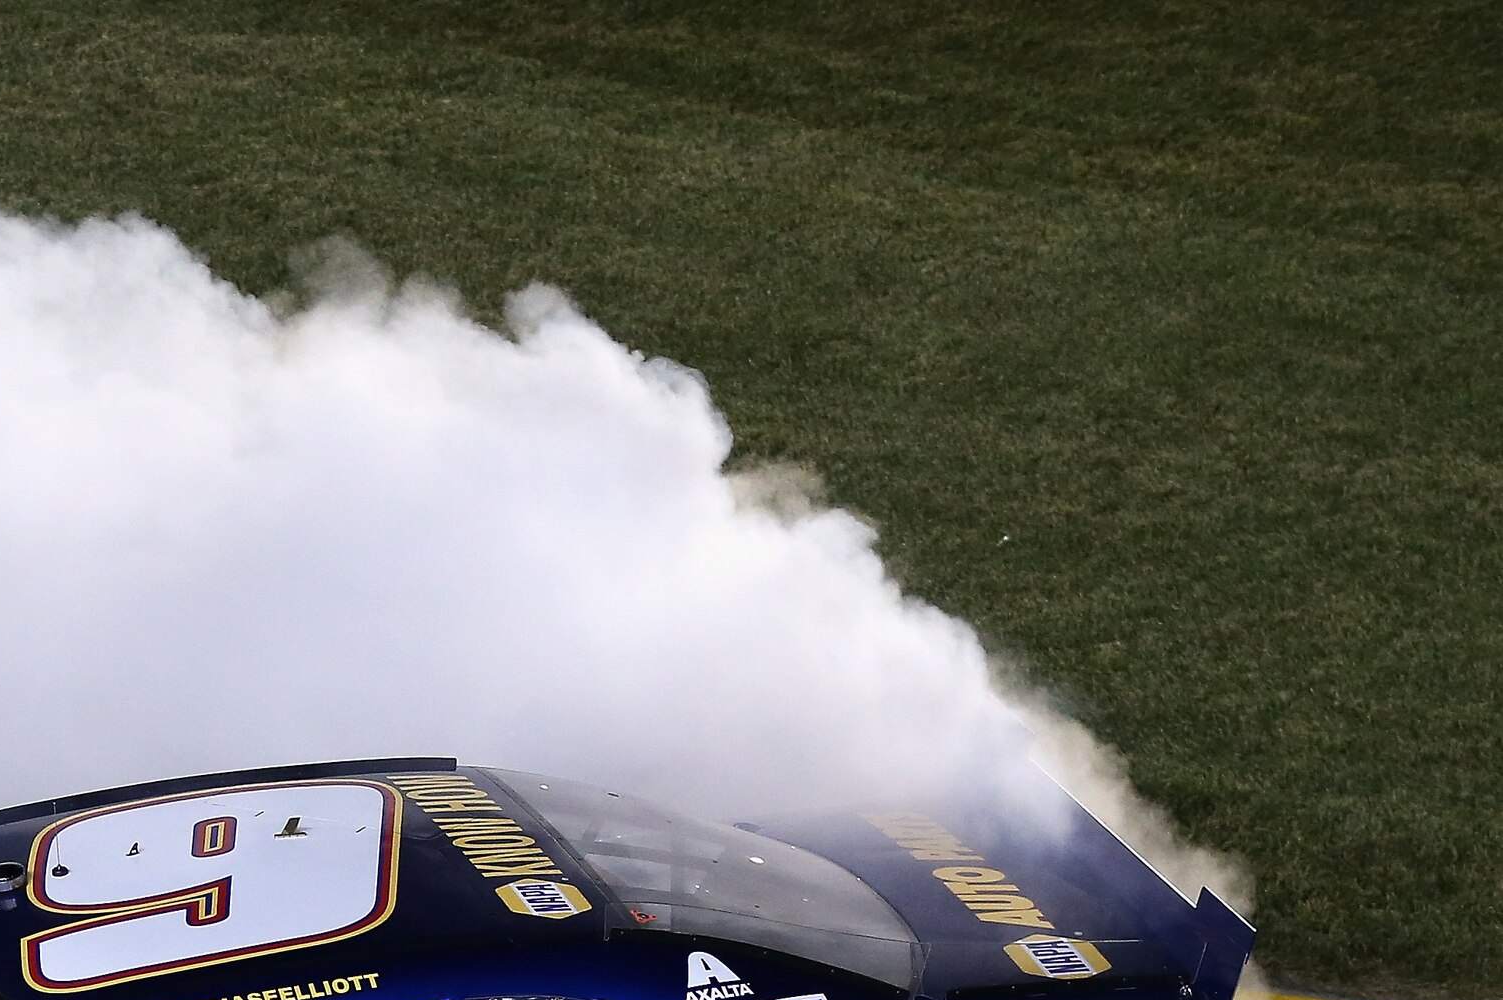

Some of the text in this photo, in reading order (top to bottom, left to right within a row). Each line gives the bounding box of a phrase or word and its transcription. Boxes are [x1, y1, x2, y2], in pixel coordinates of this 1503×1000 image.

[386, 775, 563, 878] KNOW HOW
[23, 781, 400, 991] 9
[515, 883, 572, 913] NAPA
[932, 866, 1055, 930] AUTO
[1024, 940, 1091, 975] NAPA
